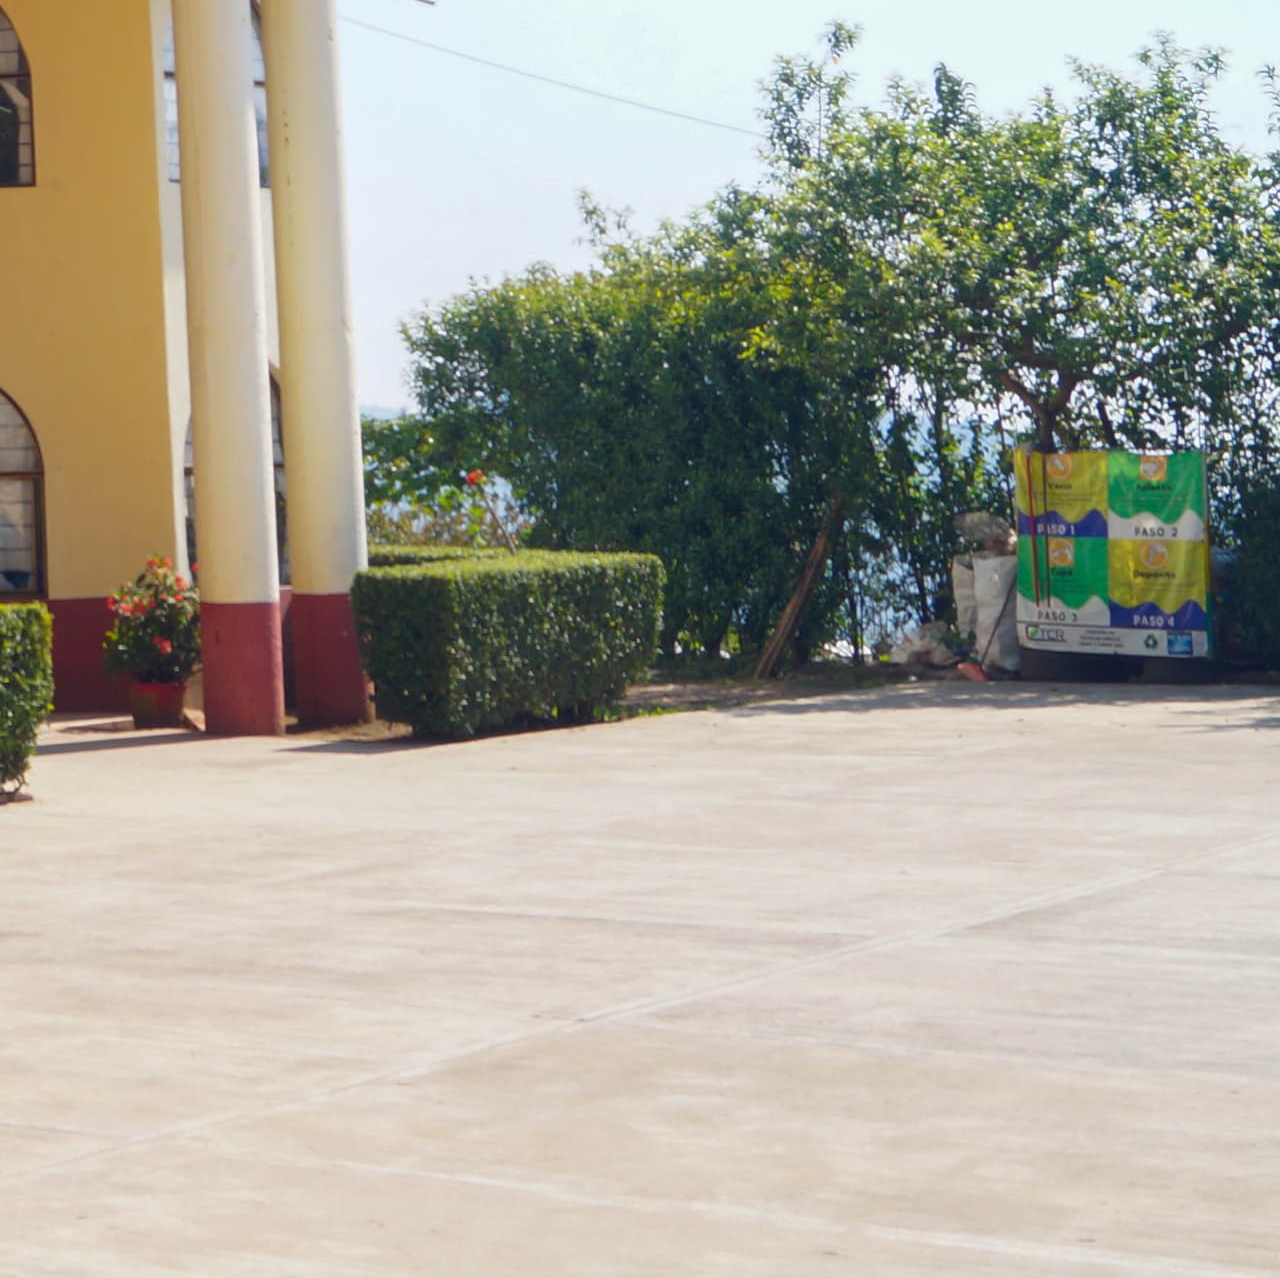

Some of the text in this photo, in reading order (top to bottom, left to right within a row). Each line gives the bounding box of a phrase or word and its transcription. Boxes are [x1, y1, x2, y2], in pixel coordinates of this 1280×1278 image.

[1134, 527, 1178, 537] PASO 2
[1038, 610, 1078, 622] PASO 3
[1133, 615, 1175, 627] PASO 4
